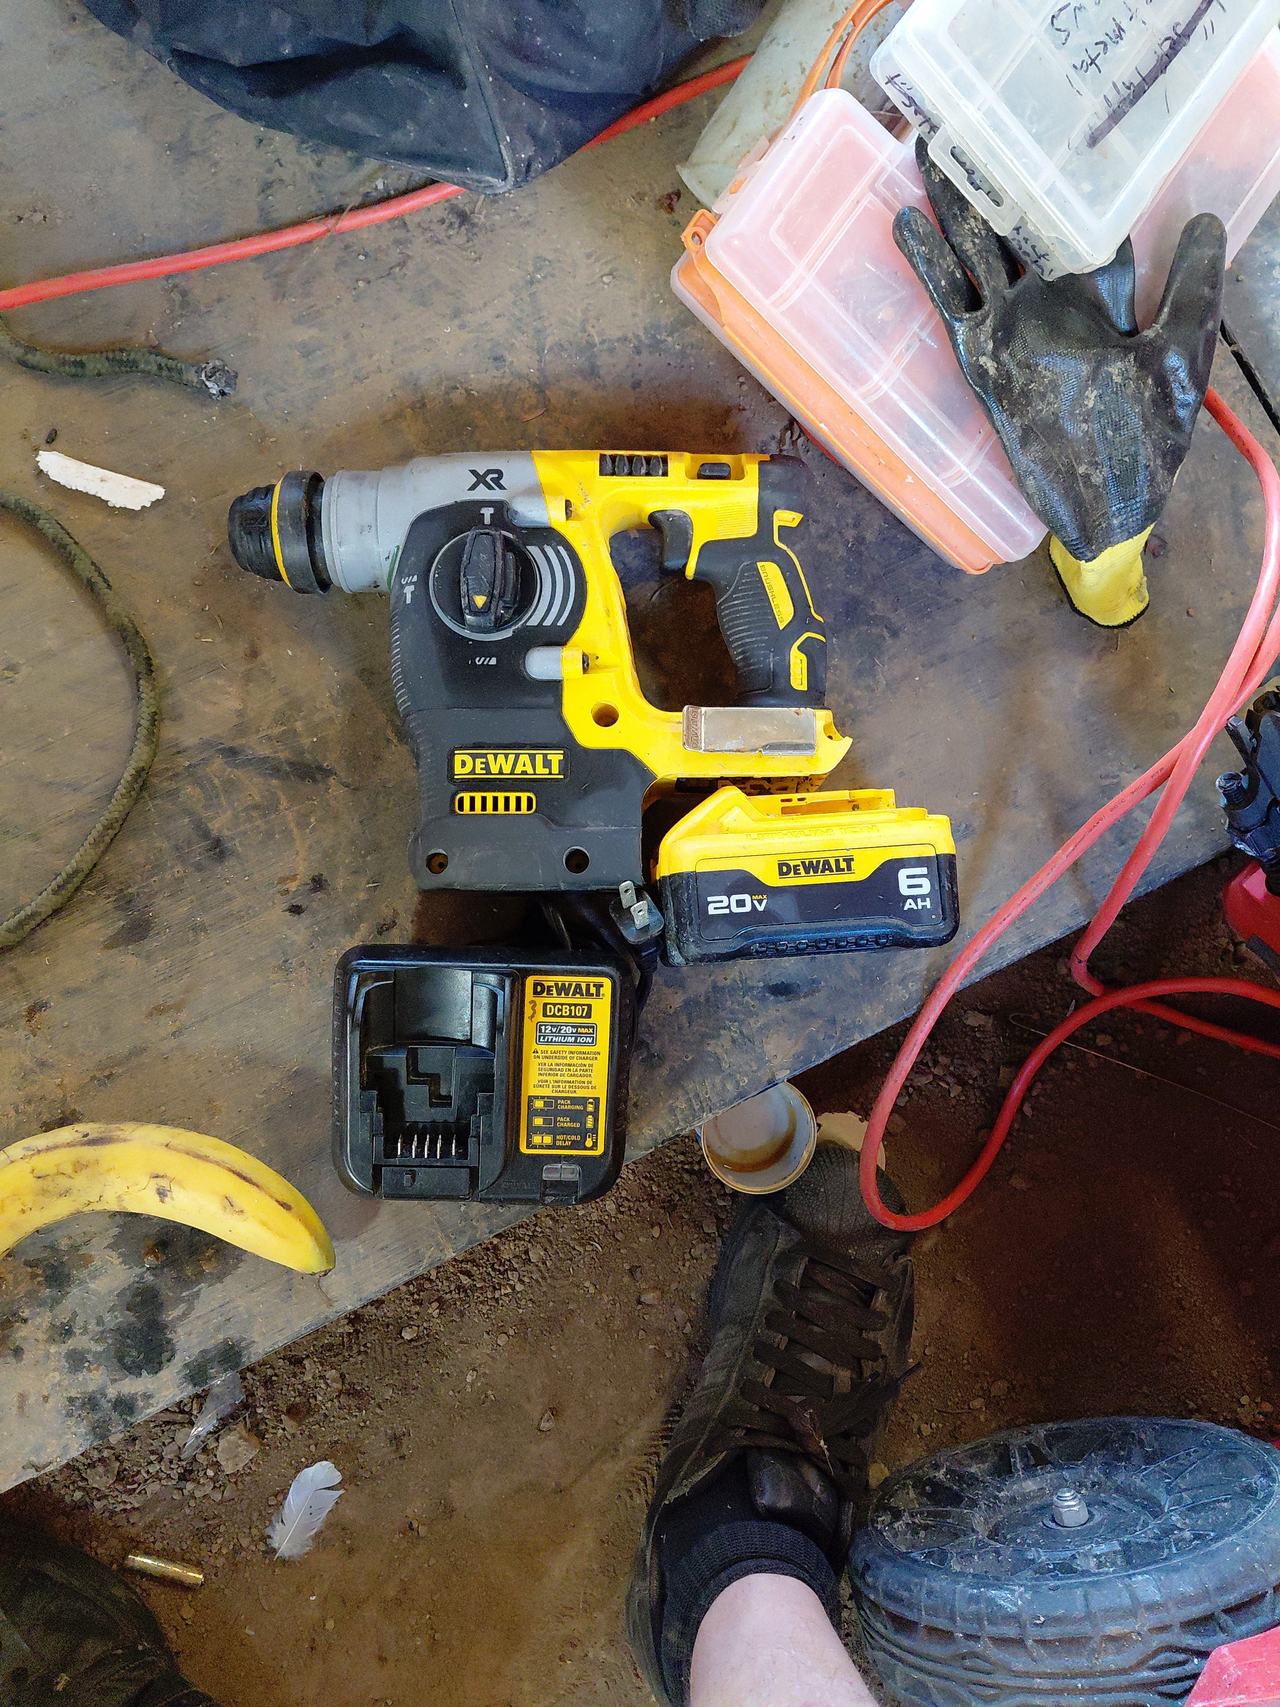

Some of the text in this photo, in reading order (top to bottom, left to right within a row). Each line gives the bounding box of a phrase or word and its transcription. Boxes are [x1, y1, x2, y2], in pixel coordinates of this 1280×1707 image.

[467, 468, 508, 491] XR
[454, 754, 564, 774] DEWALT
[777, 857, 855, 878] DEWALT
[898, 867, 931, 896] 6
[707, 893, 768, 915] 20V
[903, 897, 931, 911] AH
[532, 982, 604, 998] DEWALT
[546, 1004, 588, 1017] DCB107
